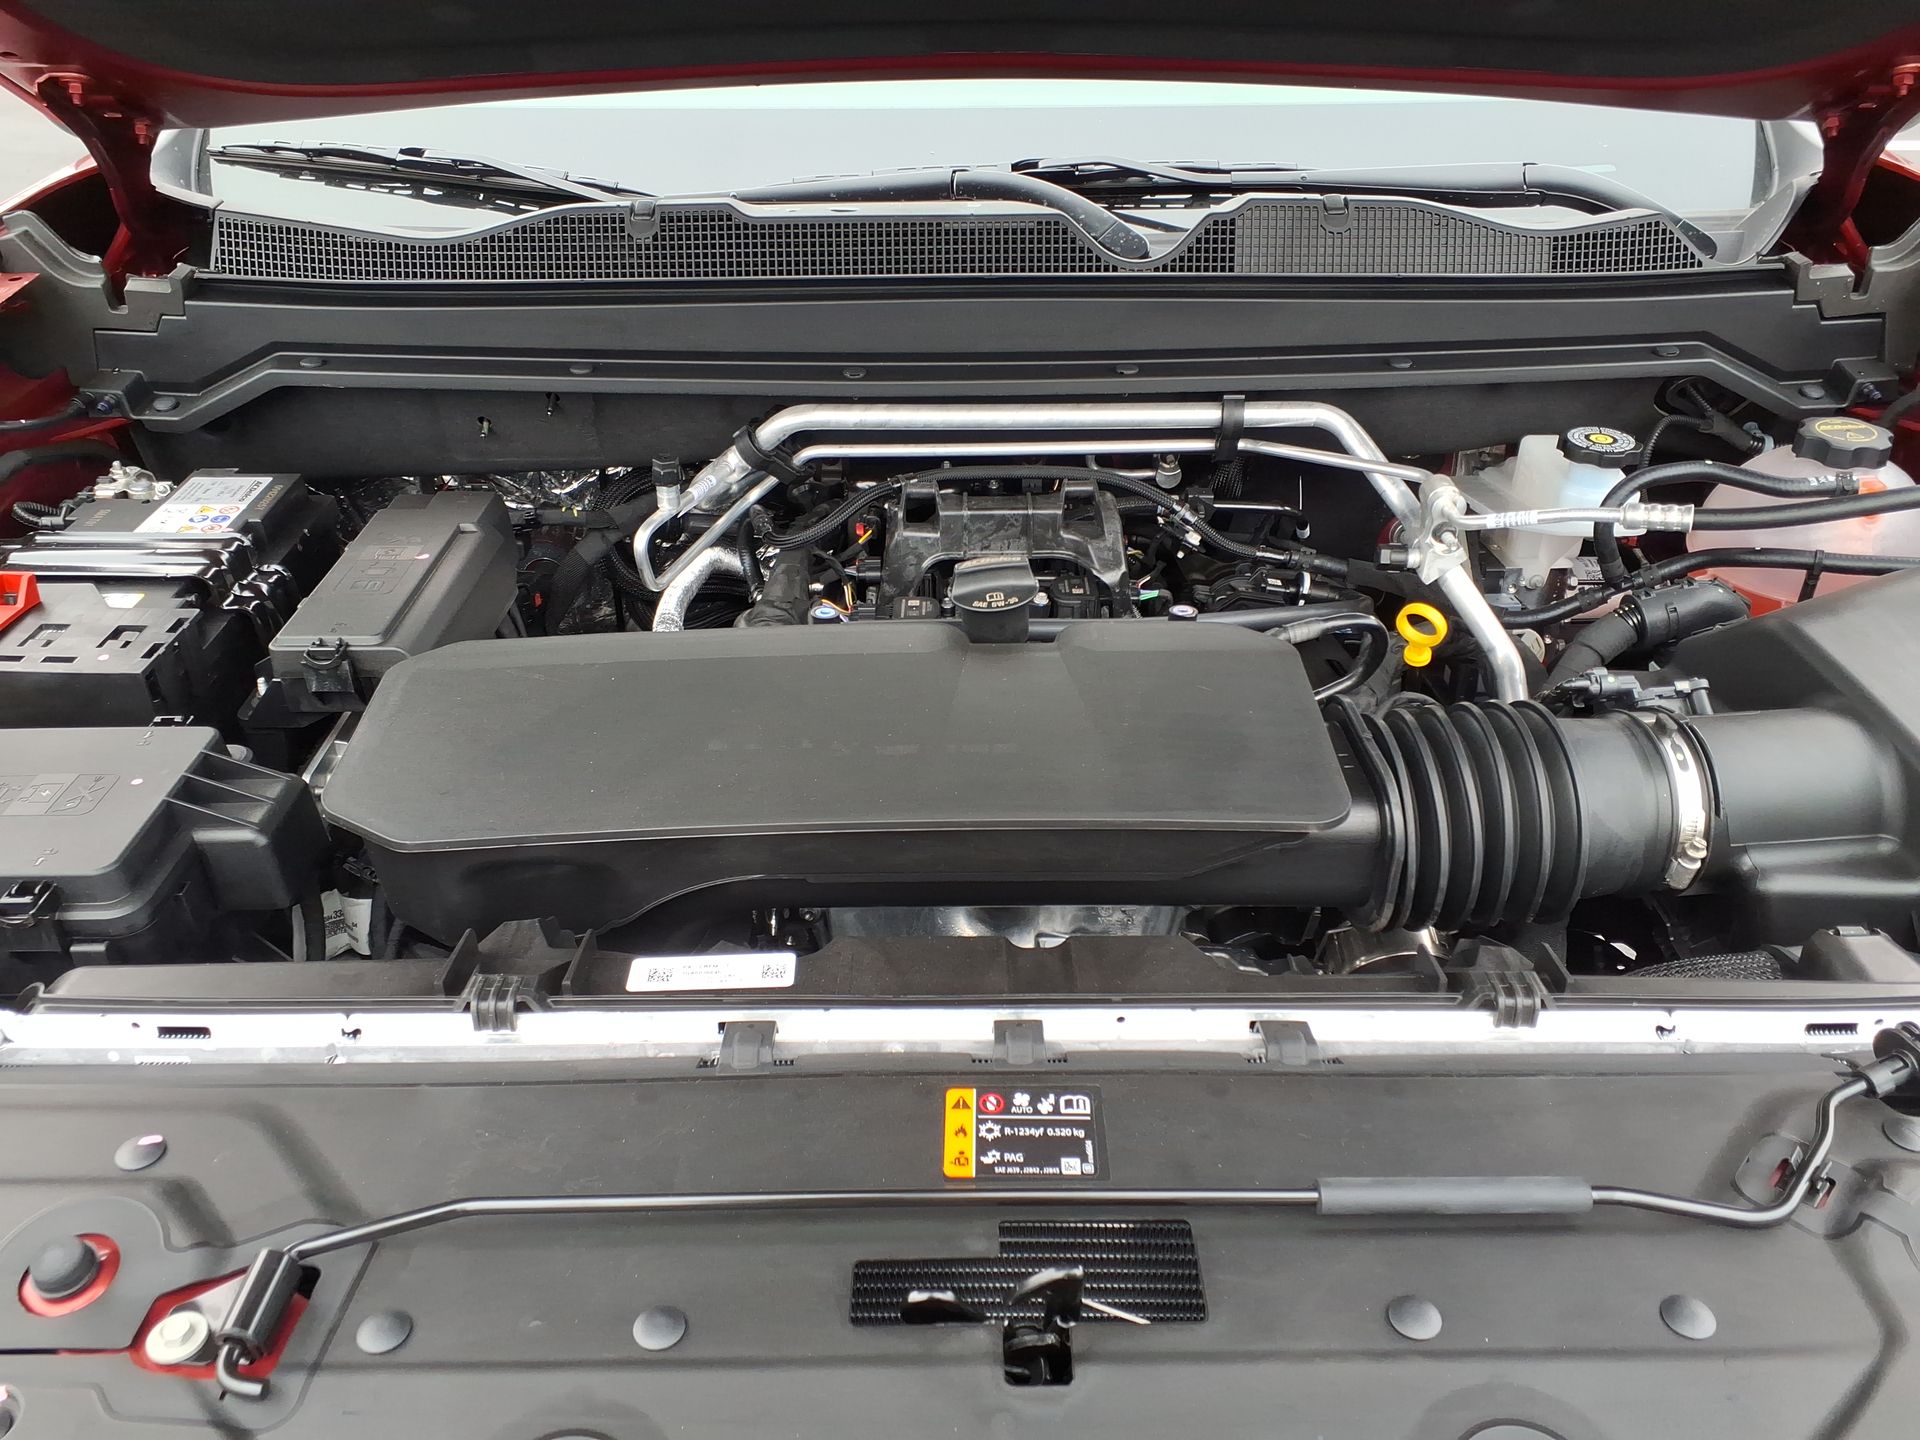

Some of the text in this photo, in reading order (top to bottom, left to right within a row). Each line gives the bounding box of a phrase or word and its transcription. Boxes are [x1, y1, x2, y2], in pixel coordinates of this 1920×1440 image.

[1011, 1106, 1033, 1114] AUTO
[1004, 1127, 1085, 1138] R-1234yf 0.520 kg
[1003, 1153, 1024, 1163] PAG
